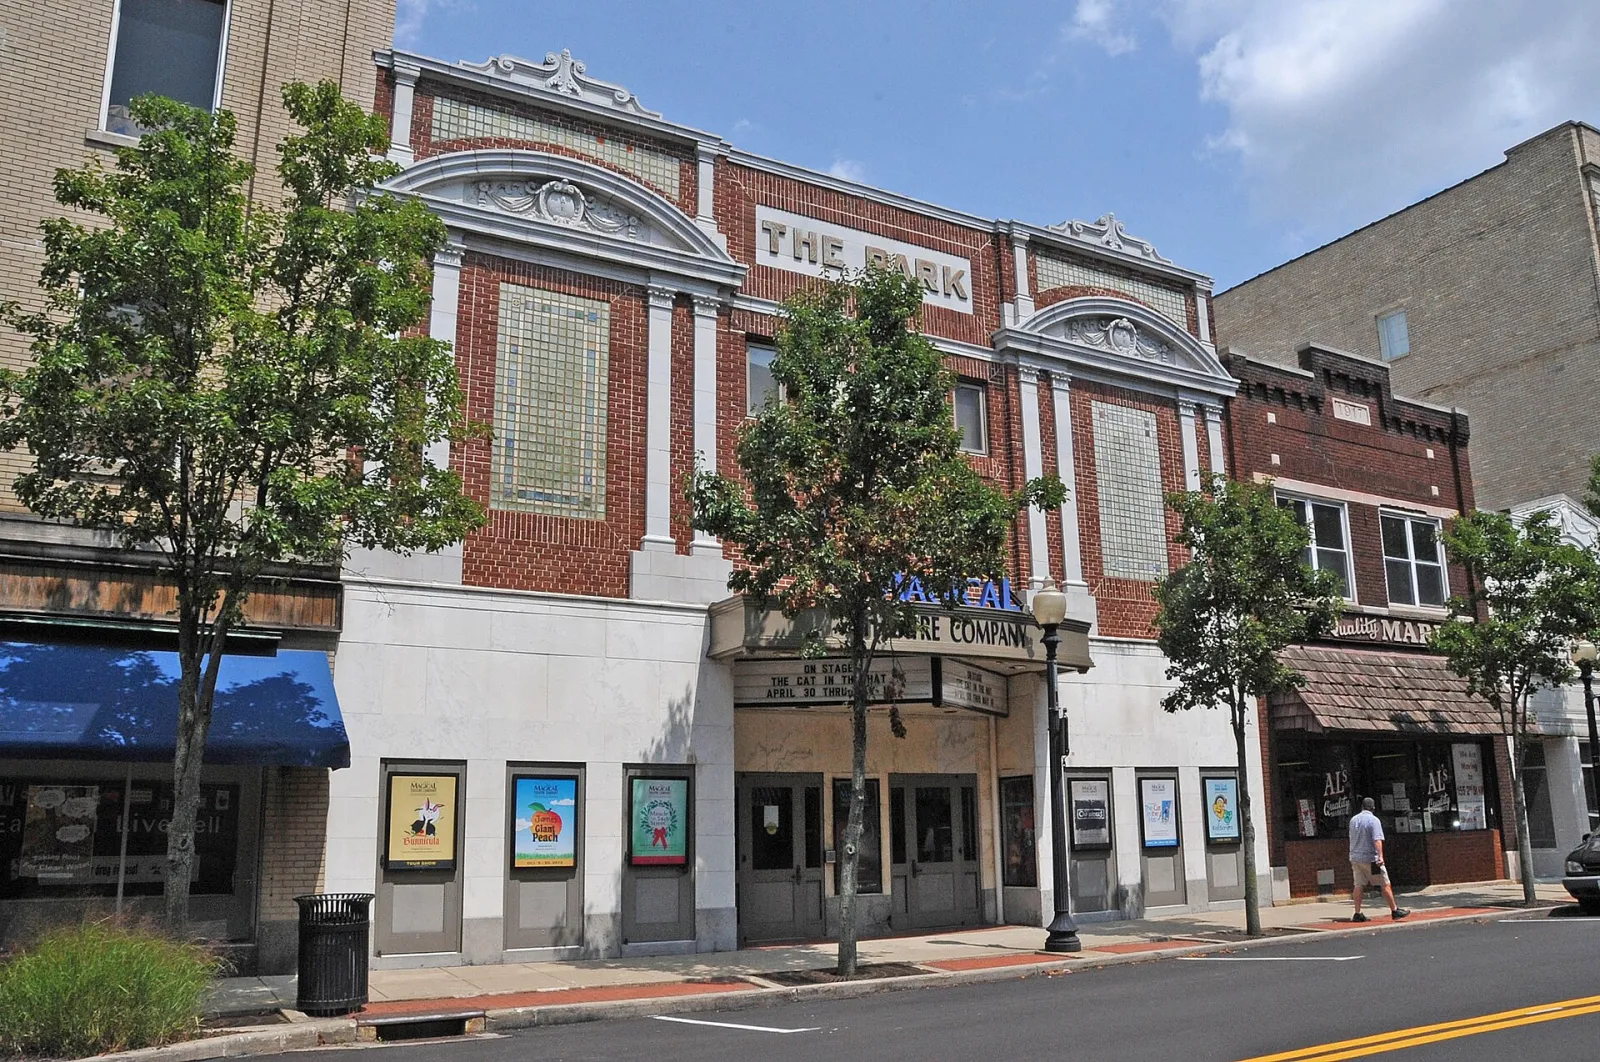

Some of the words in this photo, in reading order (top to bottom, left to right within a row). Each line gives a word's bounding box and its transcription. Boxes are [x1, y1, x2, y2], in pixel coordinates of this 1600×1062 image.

[761, 219, 844, 270] THE
[865, 245, 968, 300] PARK
[950, 616, 1026, 649] COMPANY
[804, 664, 816, 673] ON
[822, 663, 853, 673] STAGE
[771, 677, 789, 686] THE
[797, 676, 816, 685] CAT
[824, 675, 834, 684] IN
[841, 674, 854, 684] TH
[867, 674, 887, 684] HAT
[766, 688, 795, 698] APRIL
[804, 688, 816, 697] 30
[823, 686, 848, 696] THRU
[0, 816, 21, 833] Ea
[115, 814, 169, 833] Live
[192, 815, 220, 834] ell
[535, 824, 555, 833] Giant
[403, 837, 440, 846] Bunnicula
[532, 832, 558, 843] Peach
